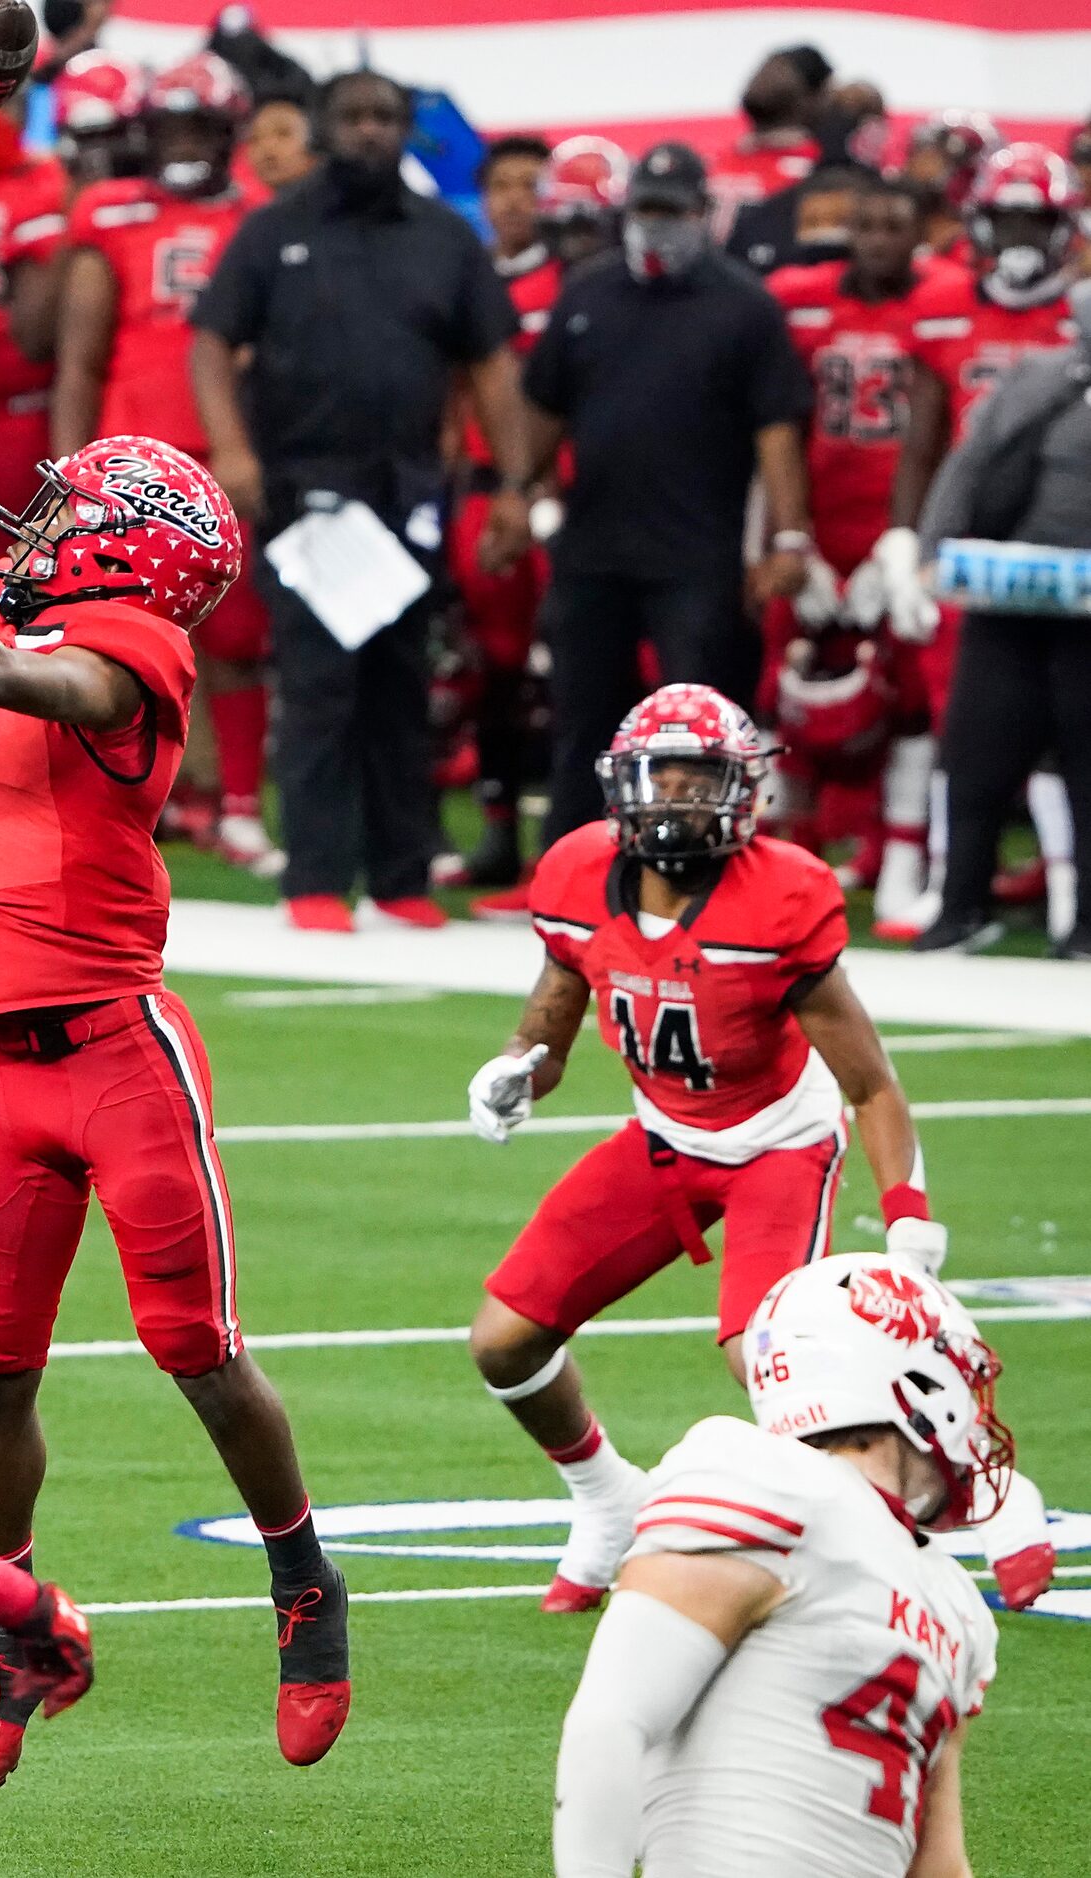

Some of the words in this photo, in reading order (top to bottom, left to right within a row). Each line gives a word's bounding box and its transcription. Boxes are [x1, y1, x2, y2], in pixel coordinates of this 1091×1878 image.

[104, 456, 220, 538] Horns
[610, 987, 718, 1092] 14
[888, 1588, 960, 1681] KATY
